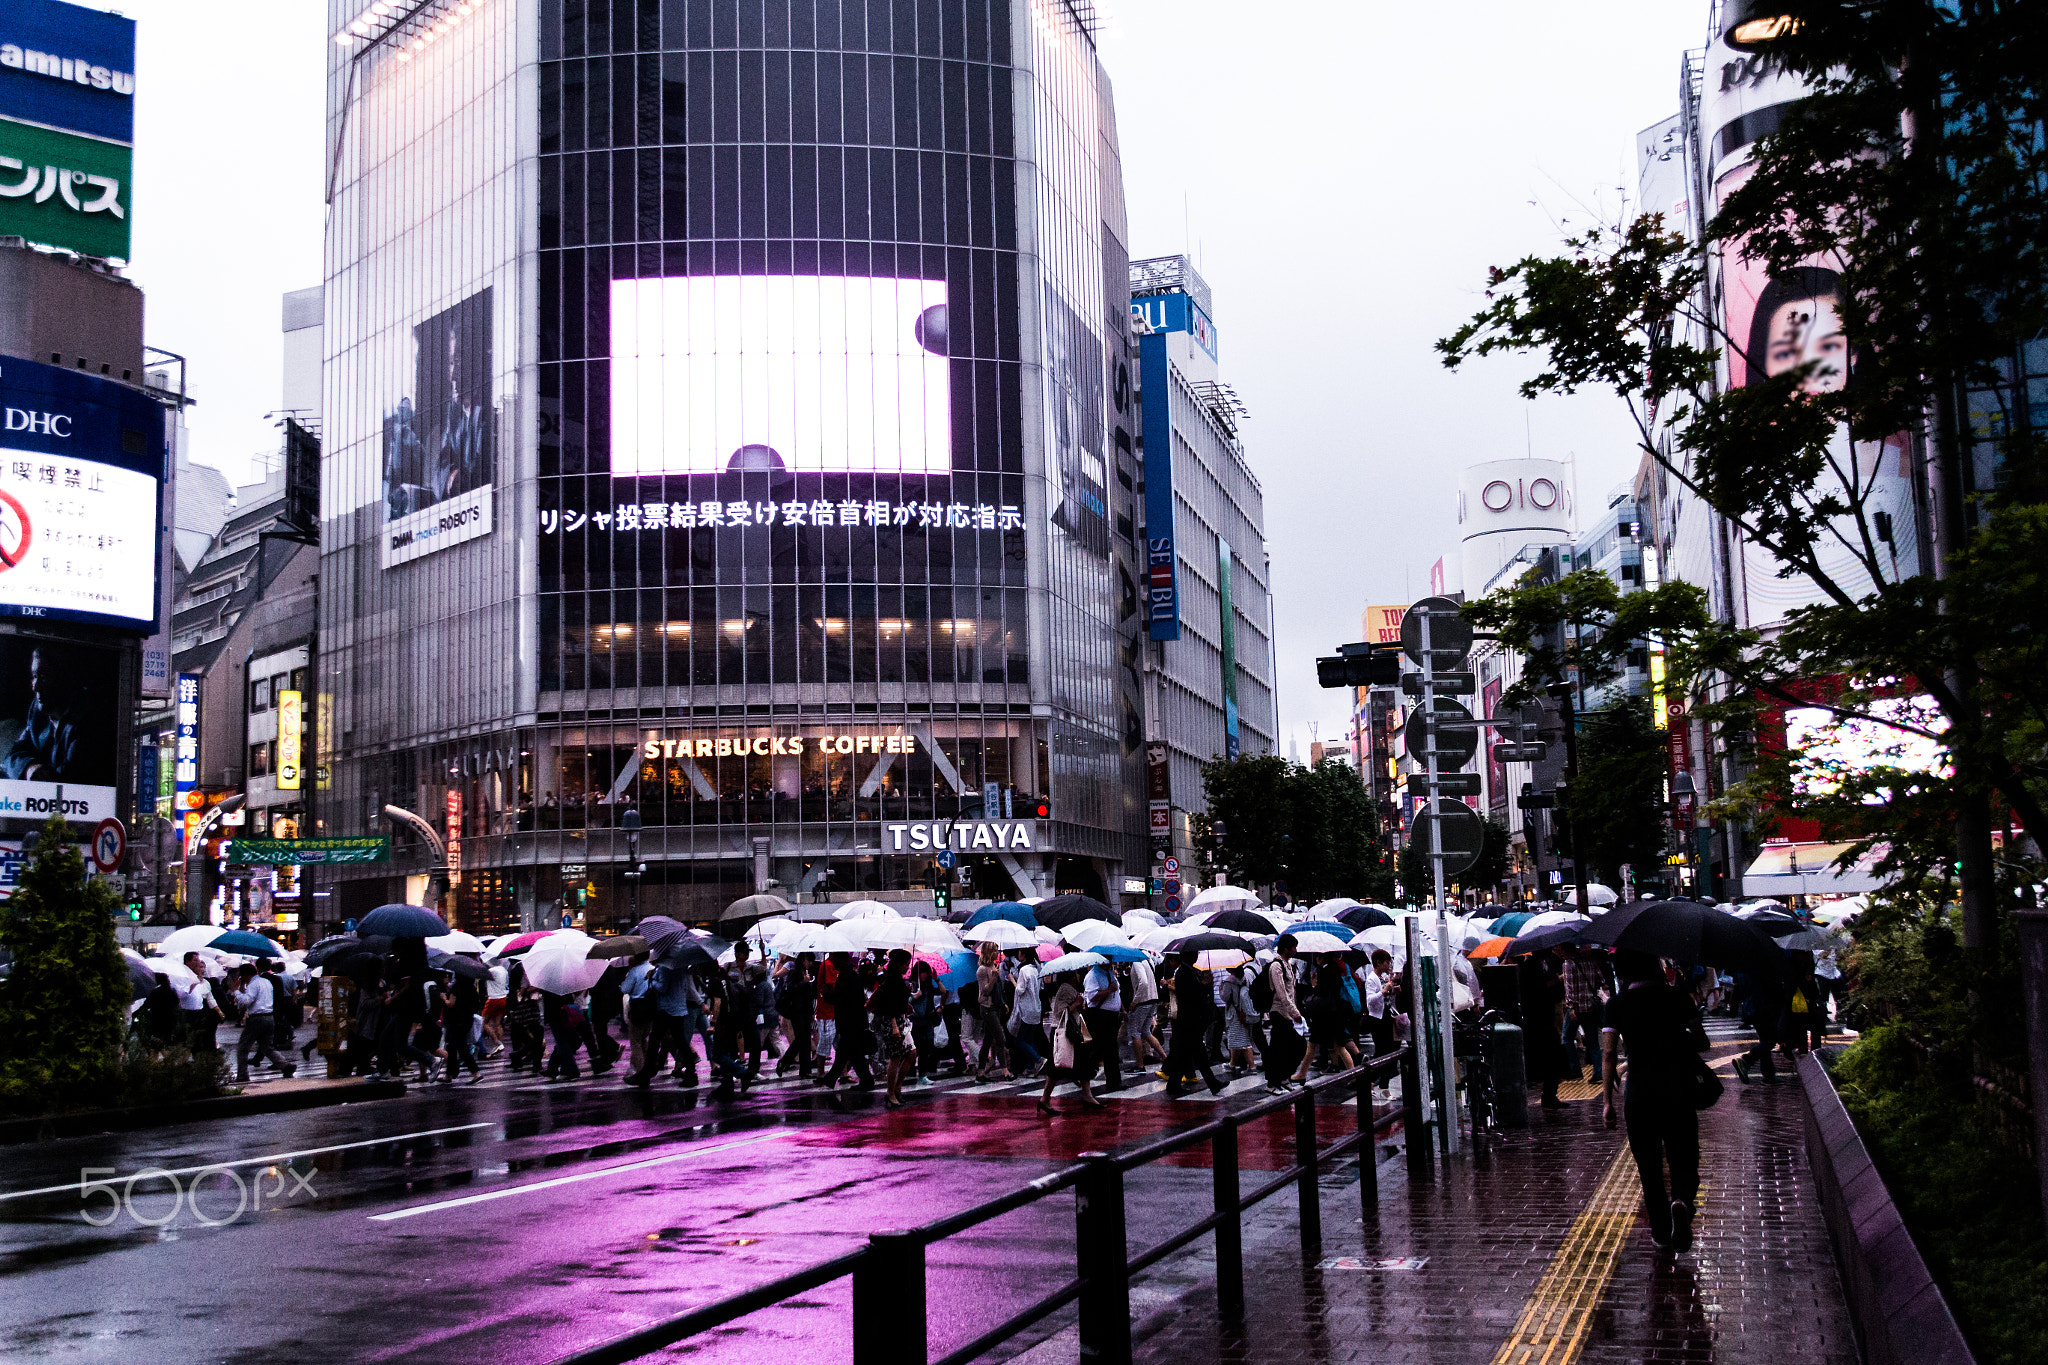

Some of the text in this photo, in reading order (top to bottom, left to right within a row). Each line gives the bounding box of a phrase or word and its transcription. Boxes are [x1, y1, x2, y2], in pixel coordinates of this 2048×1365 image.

[0, 156, 124, 219] ンパス
[5, 408, 72, 437] DHC
[0, 460, 105, 493] 喫煙禁止
[439, 505, 480, 533] ROBOTS
[1150, 537, 1174, 621] SEIBU
[22, 606, 47, 617] DHC
[644, 735, 915, 759] STARBUCKS COFFEE
[26, 797, 89, 815] ROBOTS
[888, 823, 1031, 850] TSUTAYA
